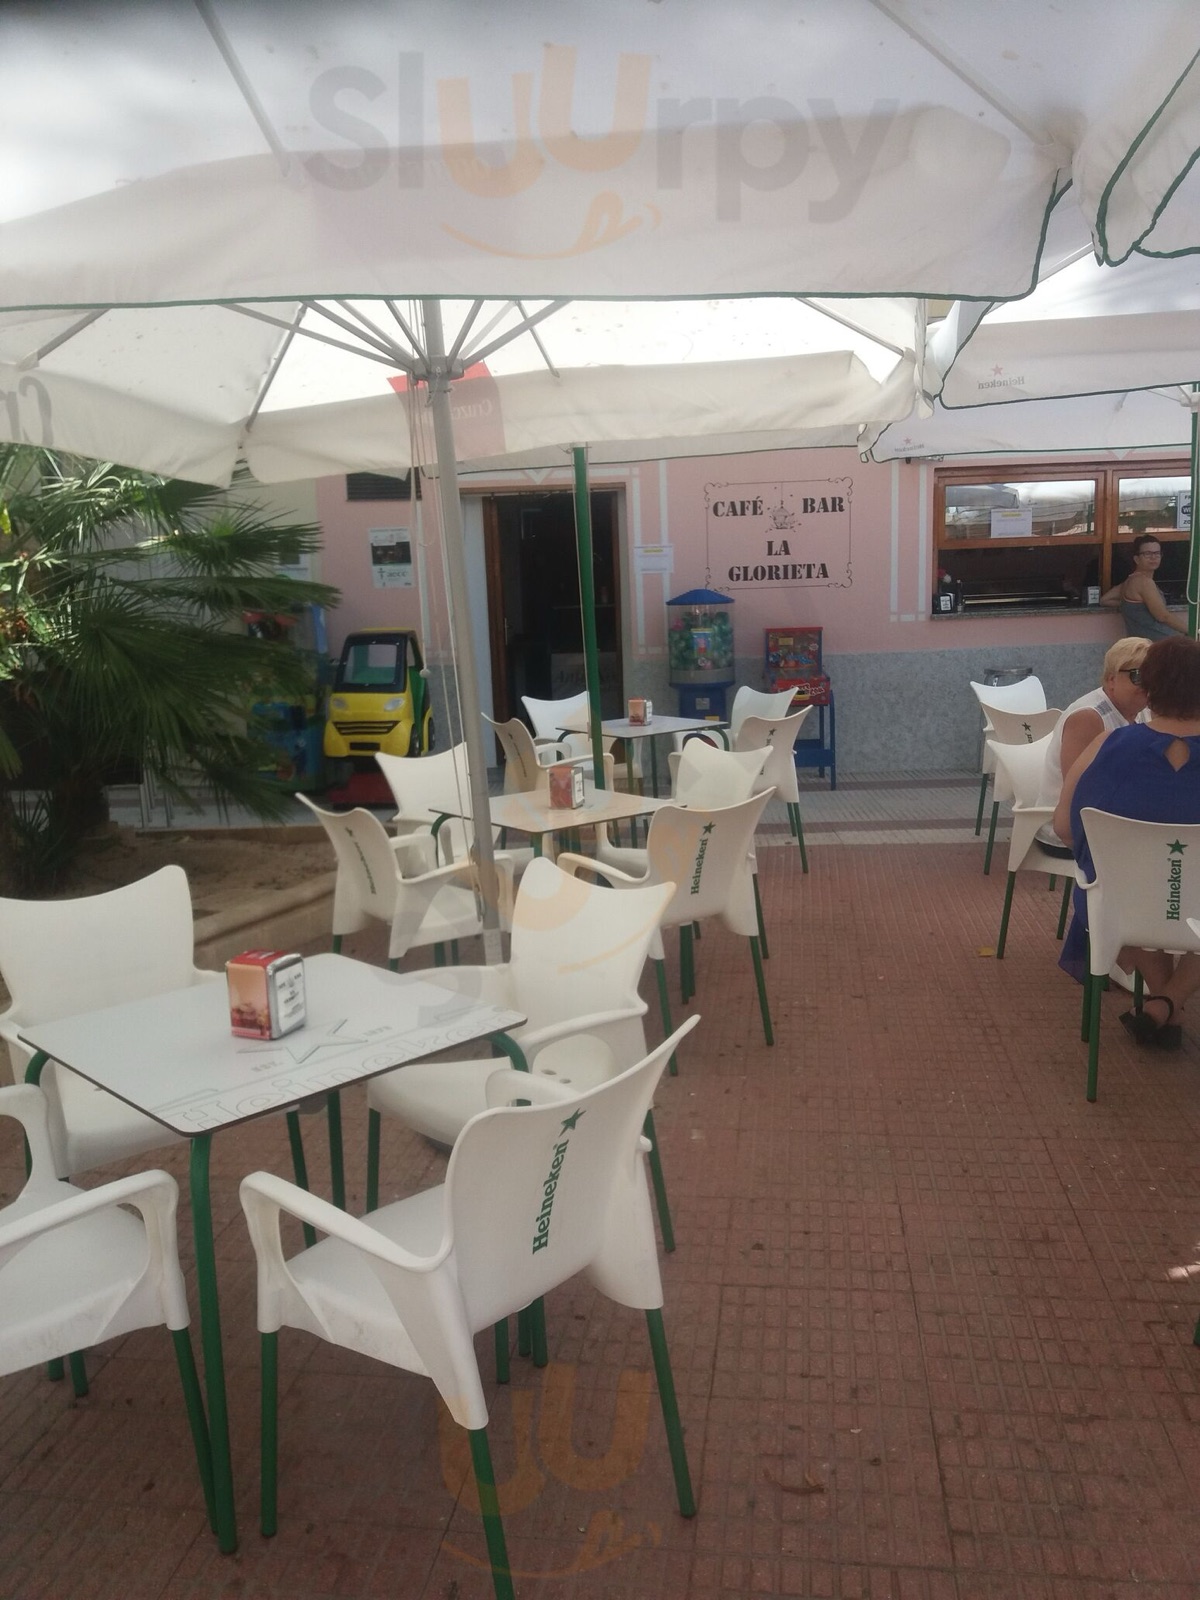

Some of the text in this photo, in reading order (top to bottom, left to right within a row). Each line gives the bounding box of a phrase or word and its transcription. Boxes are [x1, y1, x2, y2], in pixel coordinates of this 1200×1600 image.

[712, 496, 845, 517] CAFÉ BAR
[766, 540, 791, 556] LA
[728, 563, 829, 582] GLORIETA
[691, 838, 709, 895] Heineken
[1166, 858, 1182, 921] Heineken
[532, 1139, 570, 1255] Heineken
